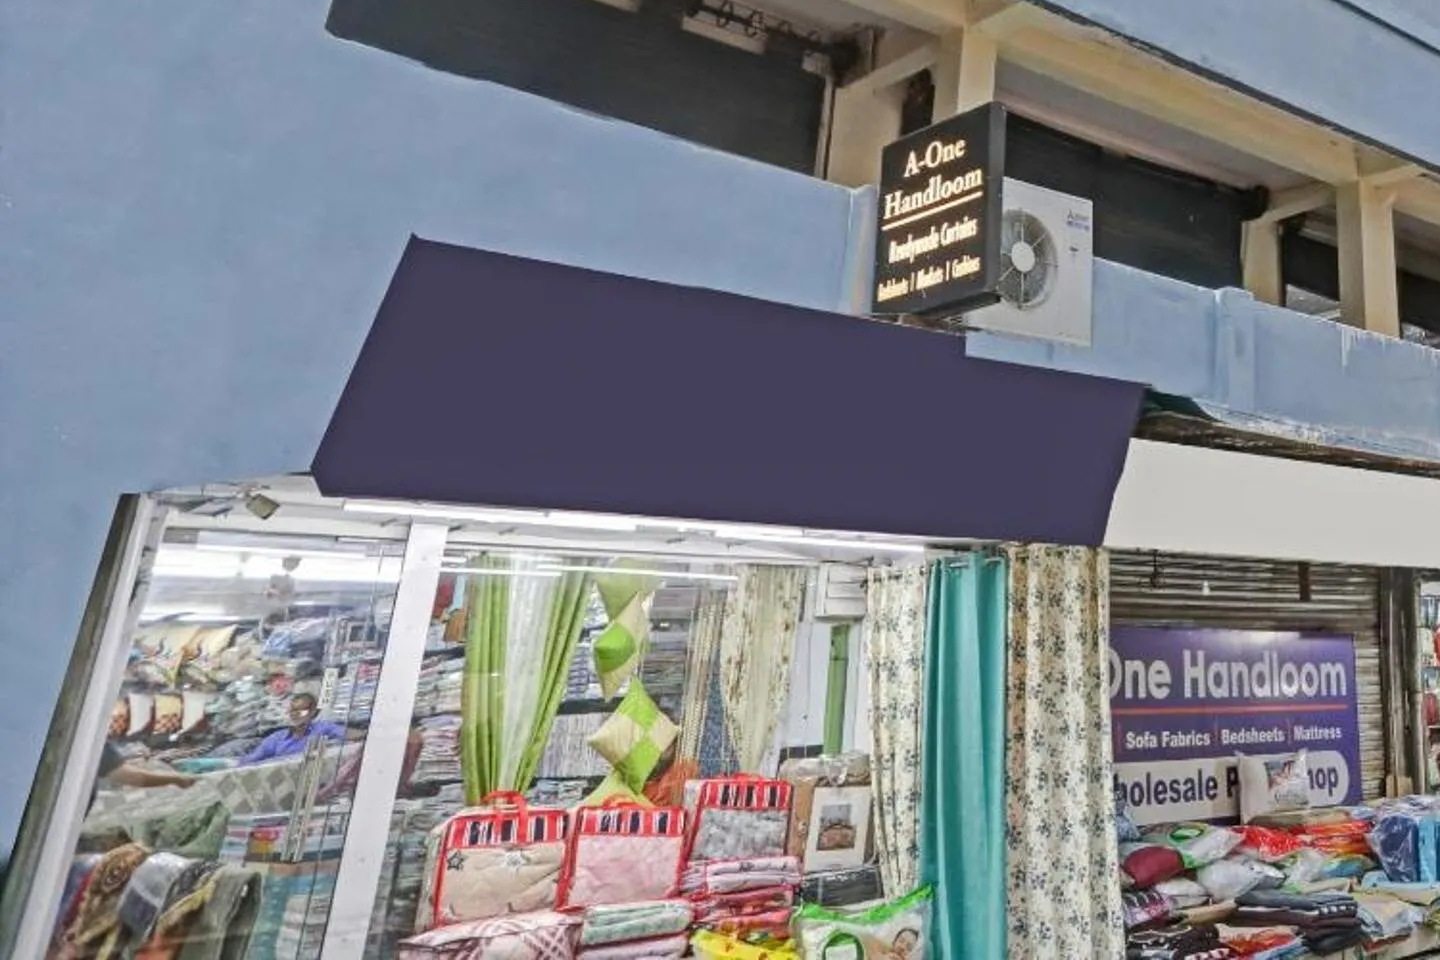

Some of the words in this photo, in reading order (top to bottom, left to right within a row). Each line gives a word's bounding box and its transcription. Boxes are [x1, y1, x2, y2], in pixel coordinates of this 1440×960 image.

[904, 139, 967, 178] A-One
[883, 168, 983, 220] Handloom
[1182, 649, 1347, 700] Handloom
[1126, 731, 1157, 749] Sofa
[1162, 730, 1211, 748] Fabrics
[1221, 725, 1285, 745] Bedsheets
[1293, 725, 1342, 741] Mattress
[1113, 767, 1218, 808] holesale
